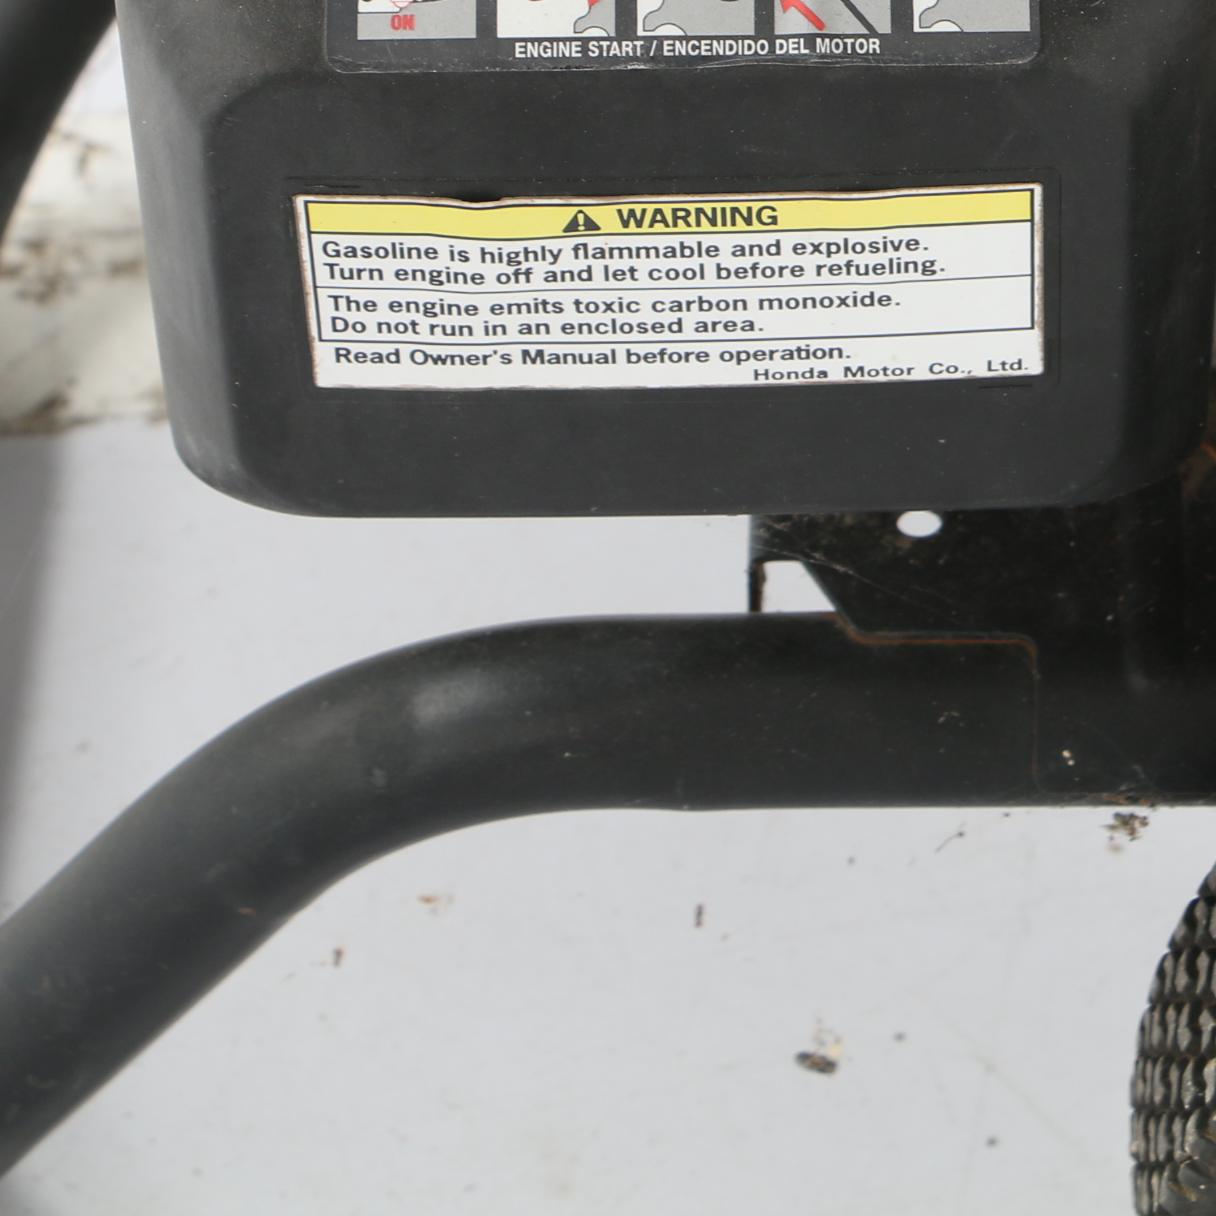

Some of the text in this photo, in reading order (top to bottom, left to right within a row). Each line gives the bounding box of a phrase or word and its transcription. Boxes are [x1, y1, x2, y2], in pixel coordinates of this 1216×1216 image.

[390, 15, 416, 31] ON
[515, 38, 880, 57] ENGINE START / ENCENDIDO DEL MOTOR
[616, 206, 777, 228] WARNING
[322, 236, 929, 266] Gasoline is highly flammable and explosive.
[323, 257, 946, 286] Turn engine off and let cool before refueling.
[328, 291, 901, 318] The engine emits toxic carbon monoxide.
[331, 317, 765, 336] Do not run in an enclosed area.
[335, 344, 851, 365] Read Owner's Manual before operation.
[754, 359, 1029, 380] Honda Motor Co., Ltd.
